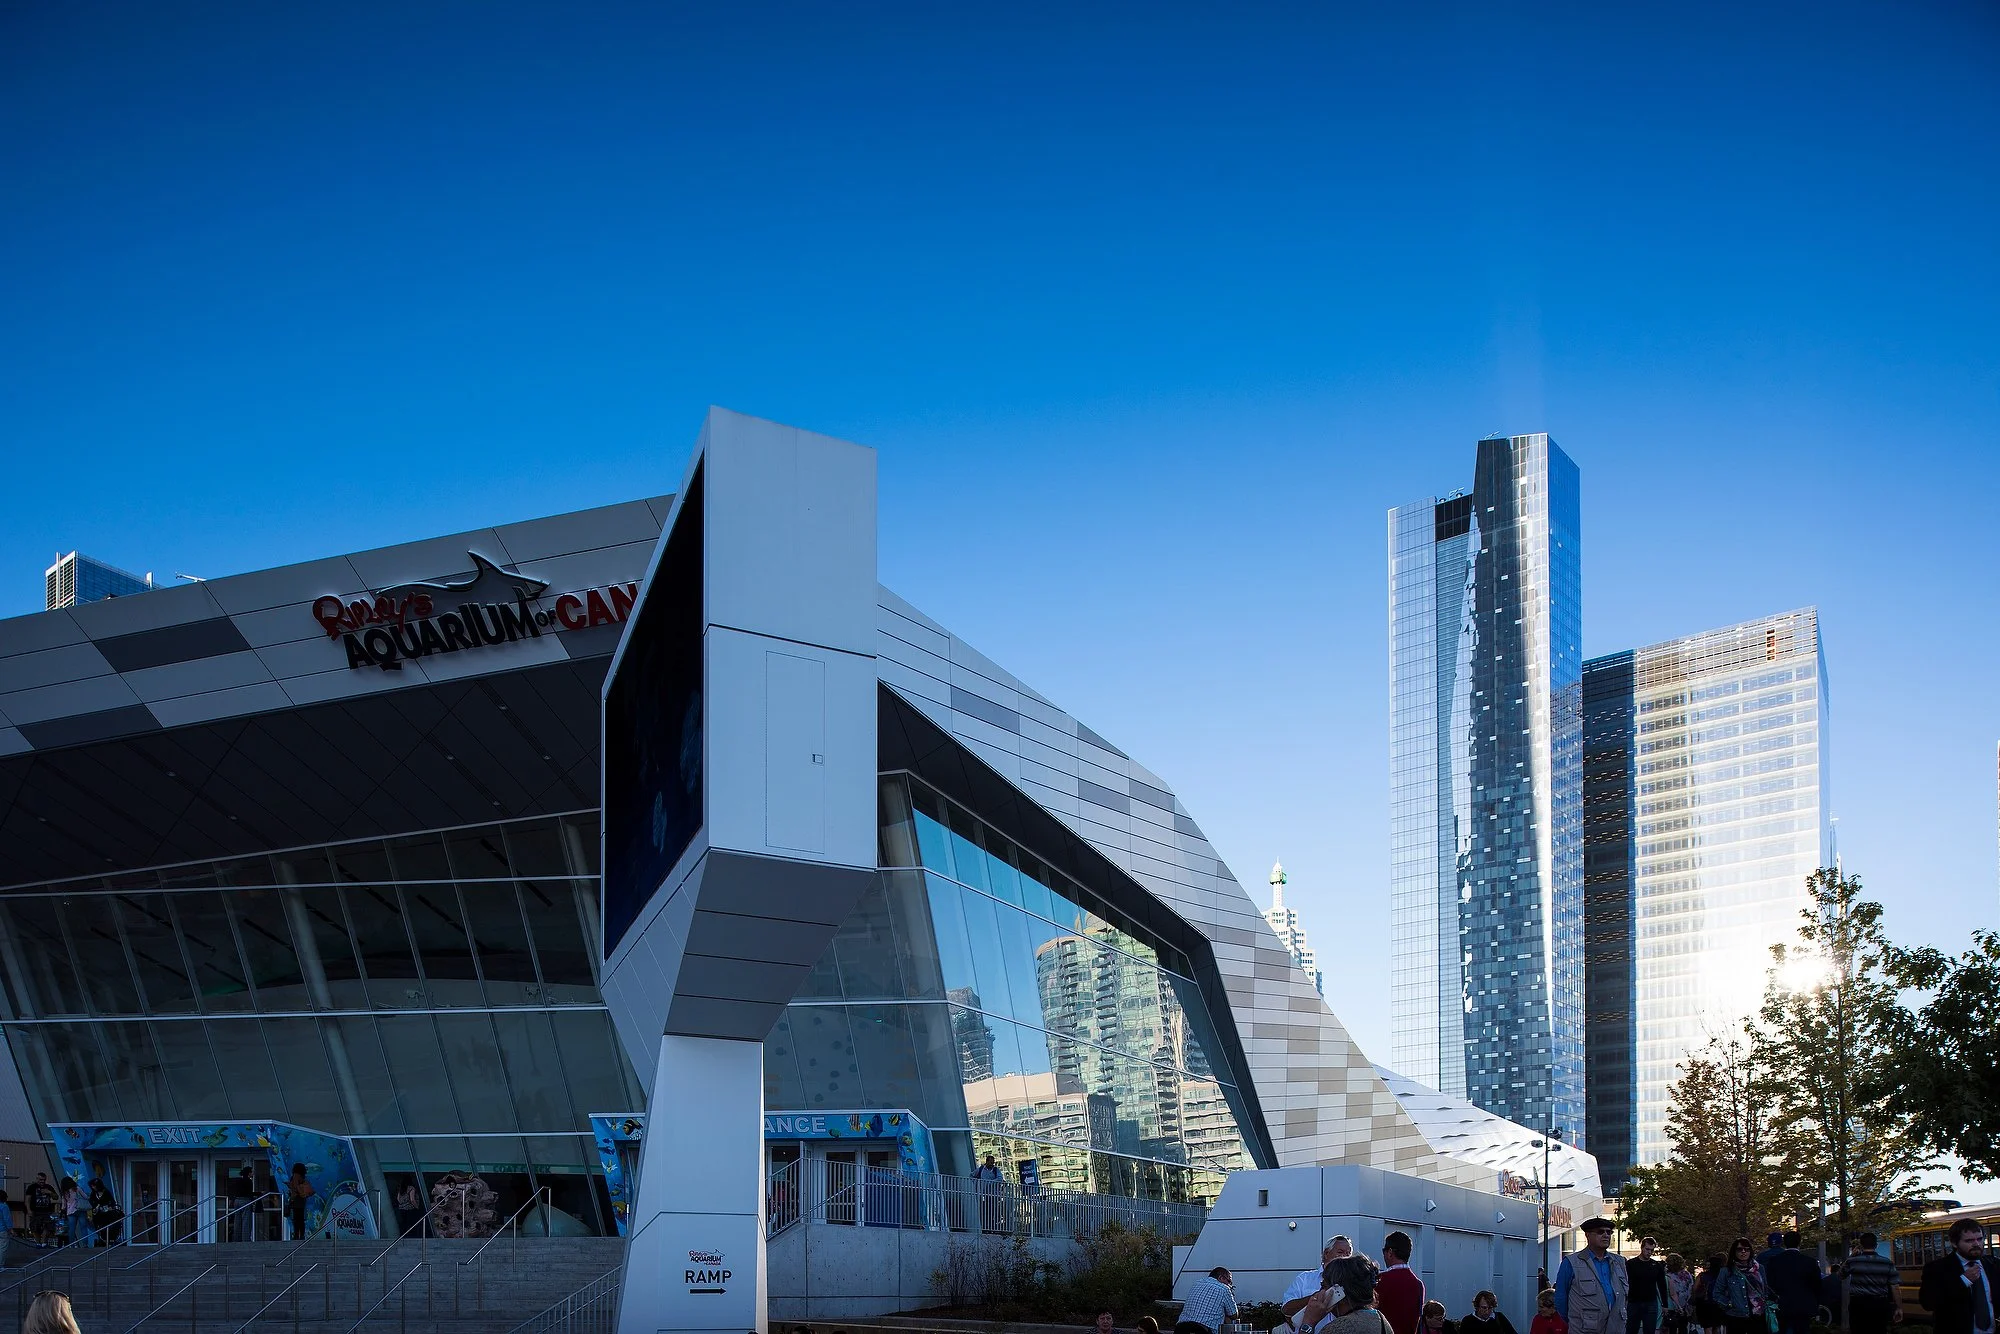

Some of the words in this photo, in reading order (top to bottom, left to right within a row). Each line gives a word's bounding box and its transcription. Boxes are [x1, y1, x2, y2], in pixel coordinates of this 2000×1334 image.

[343, 601, 542, 671] AQUARIUM
[147, 1127, 201, 1144] EXIT
[521, 1164, 551, 1174] CECK
[685, 1269, 732, 1284] RAMP
